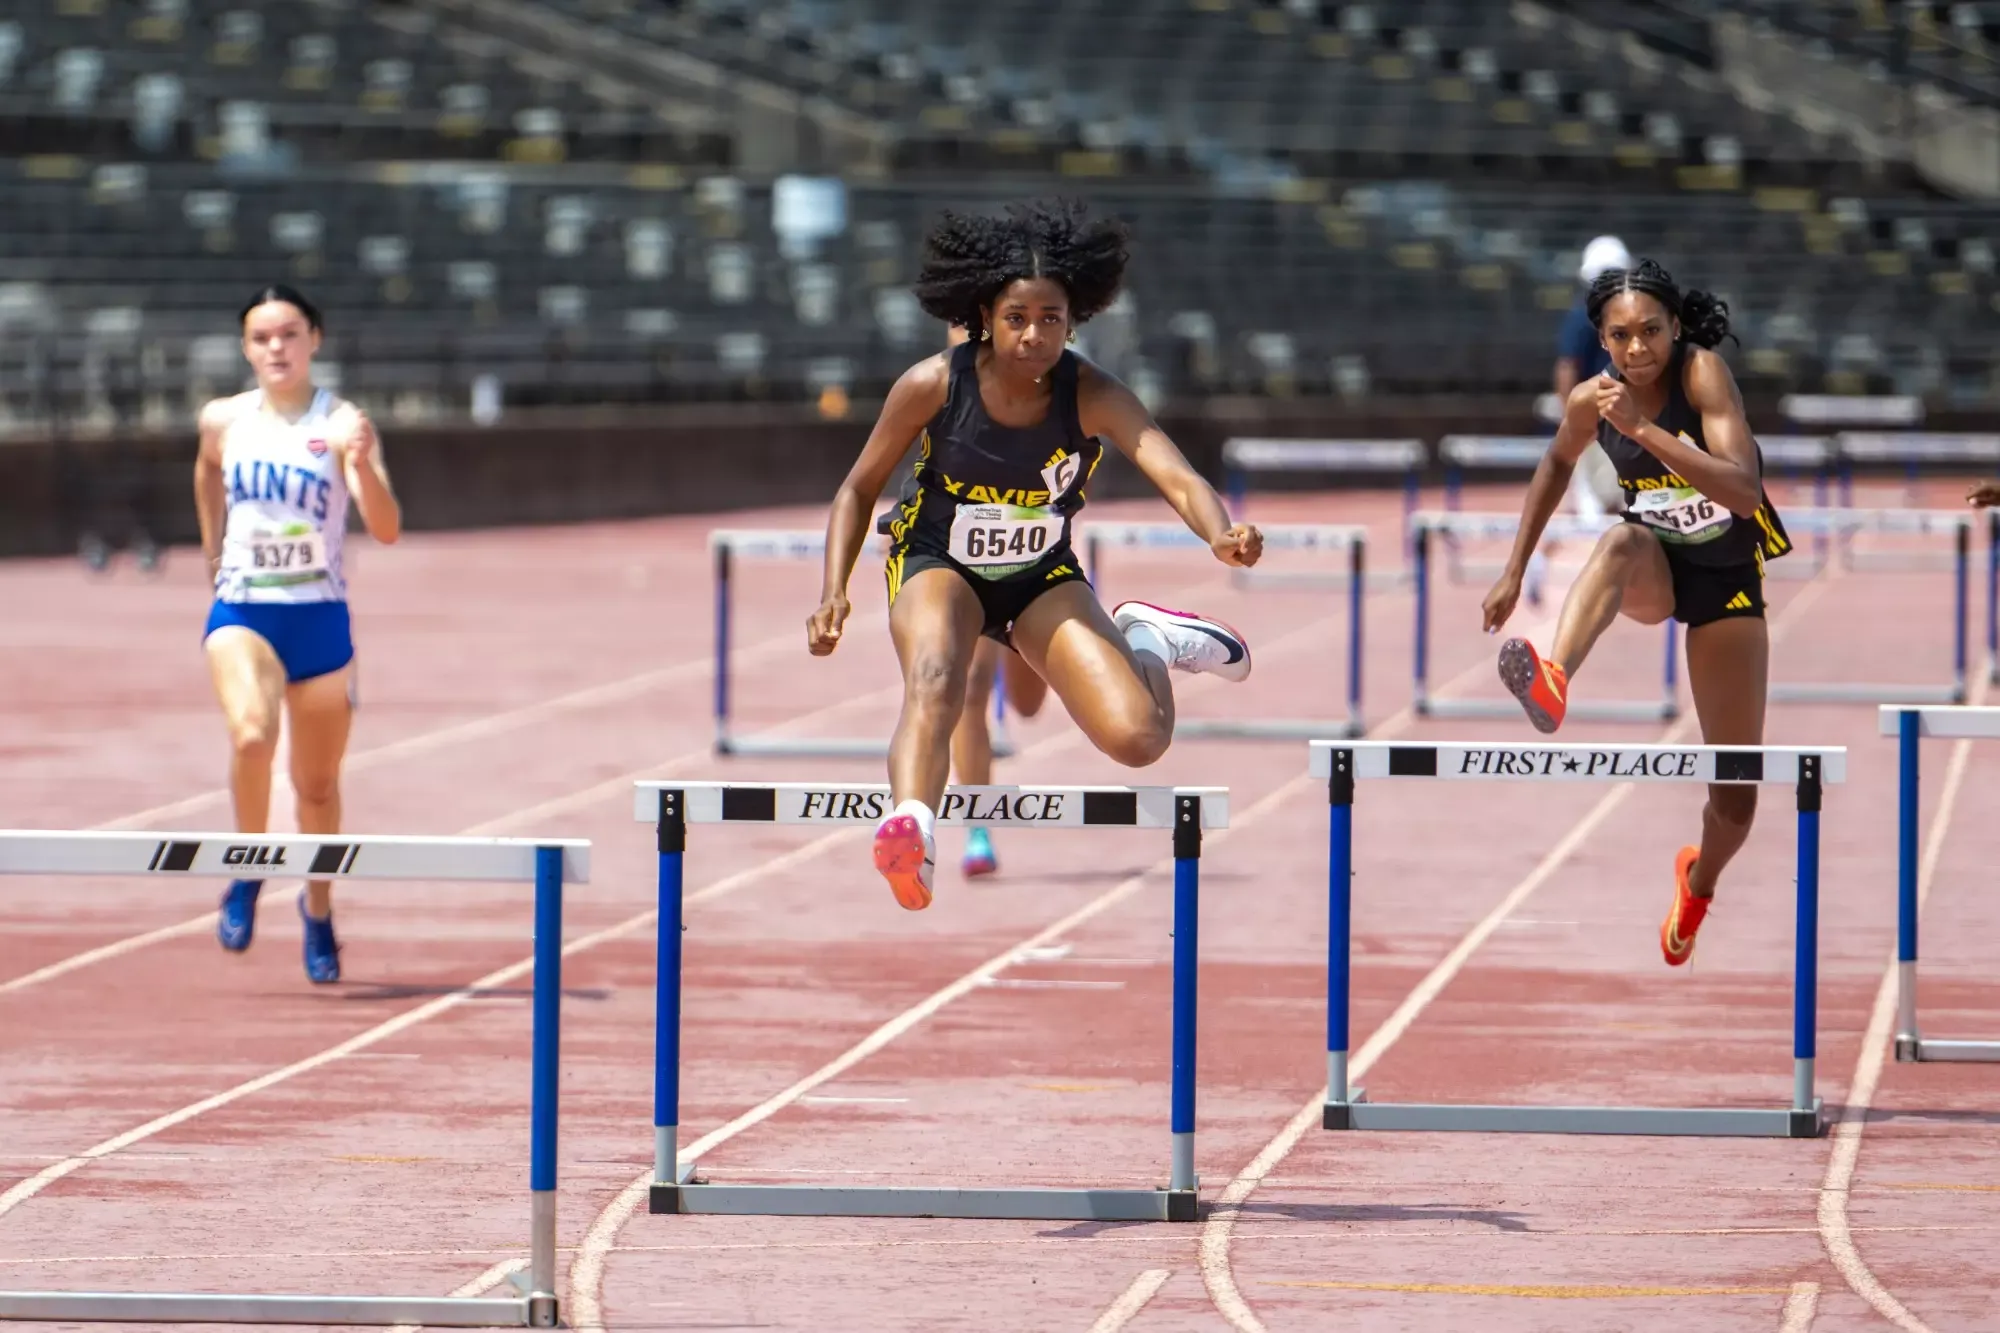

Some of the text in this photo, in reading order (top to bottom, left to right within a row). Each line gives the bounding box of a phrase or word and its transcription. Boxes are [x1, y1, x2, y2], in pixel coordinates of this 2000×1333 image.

[223, 460, 331, 520] AINTS
[943, 473, 1051, 508] XAVIE
[1054, 457, 1074, 494] 6
[966, 526, 1047, 558] 6540
[1458, 750, 1698, 777] FIRST PLACE
[798, 791, 1065, 822] FIRS PLACE
[222, 845, 287, 865] GILL
